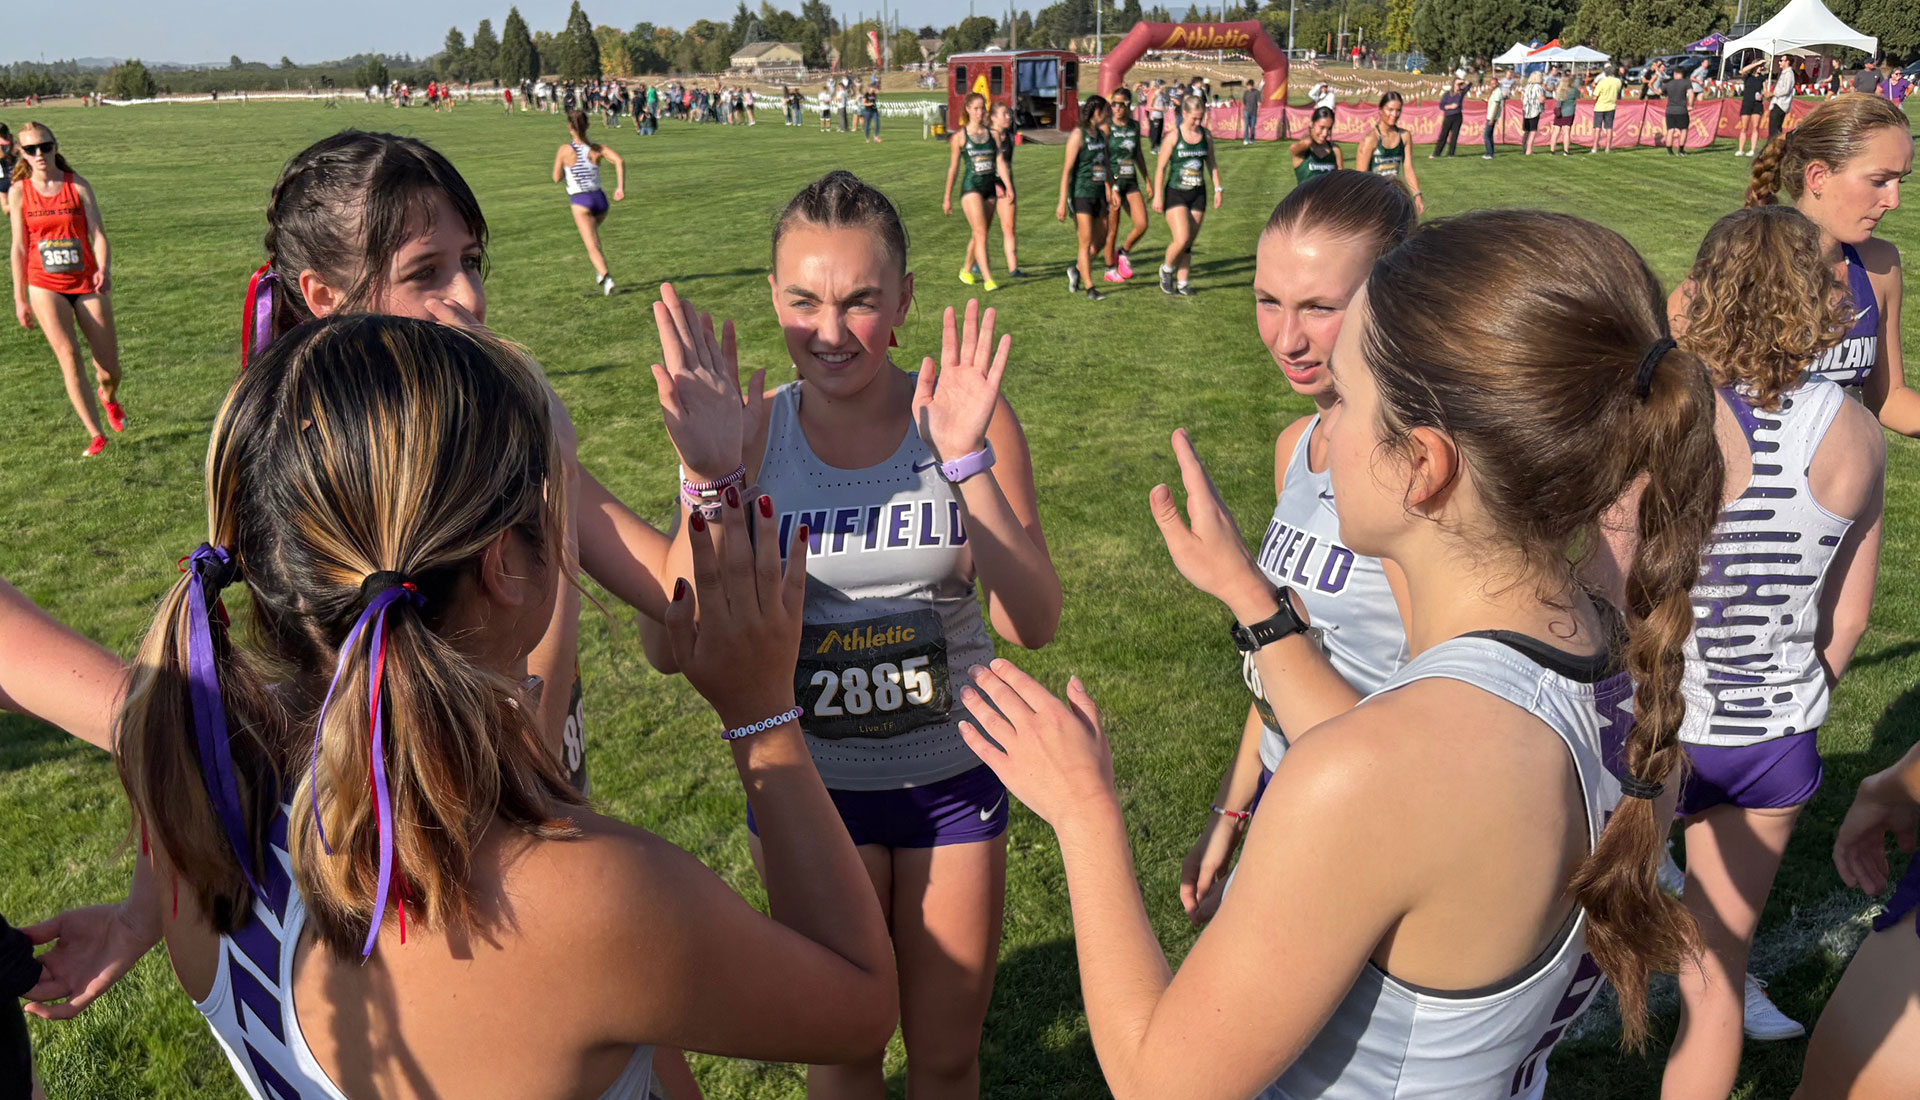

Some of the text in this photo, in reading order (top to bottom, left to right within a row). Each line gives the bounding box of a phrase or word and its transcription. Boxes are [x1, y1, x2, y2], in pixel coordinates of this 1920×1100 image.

[1161, 26, 1250, 49] Athletic
[44, 249, 79, 266] 3636
[777, 499, 969, 560] INFIELD
[816, 625, 916, 654] Athletic
[811, 655, 933, 717] 2885
[729, 708, 799, 739] WILDCATS
